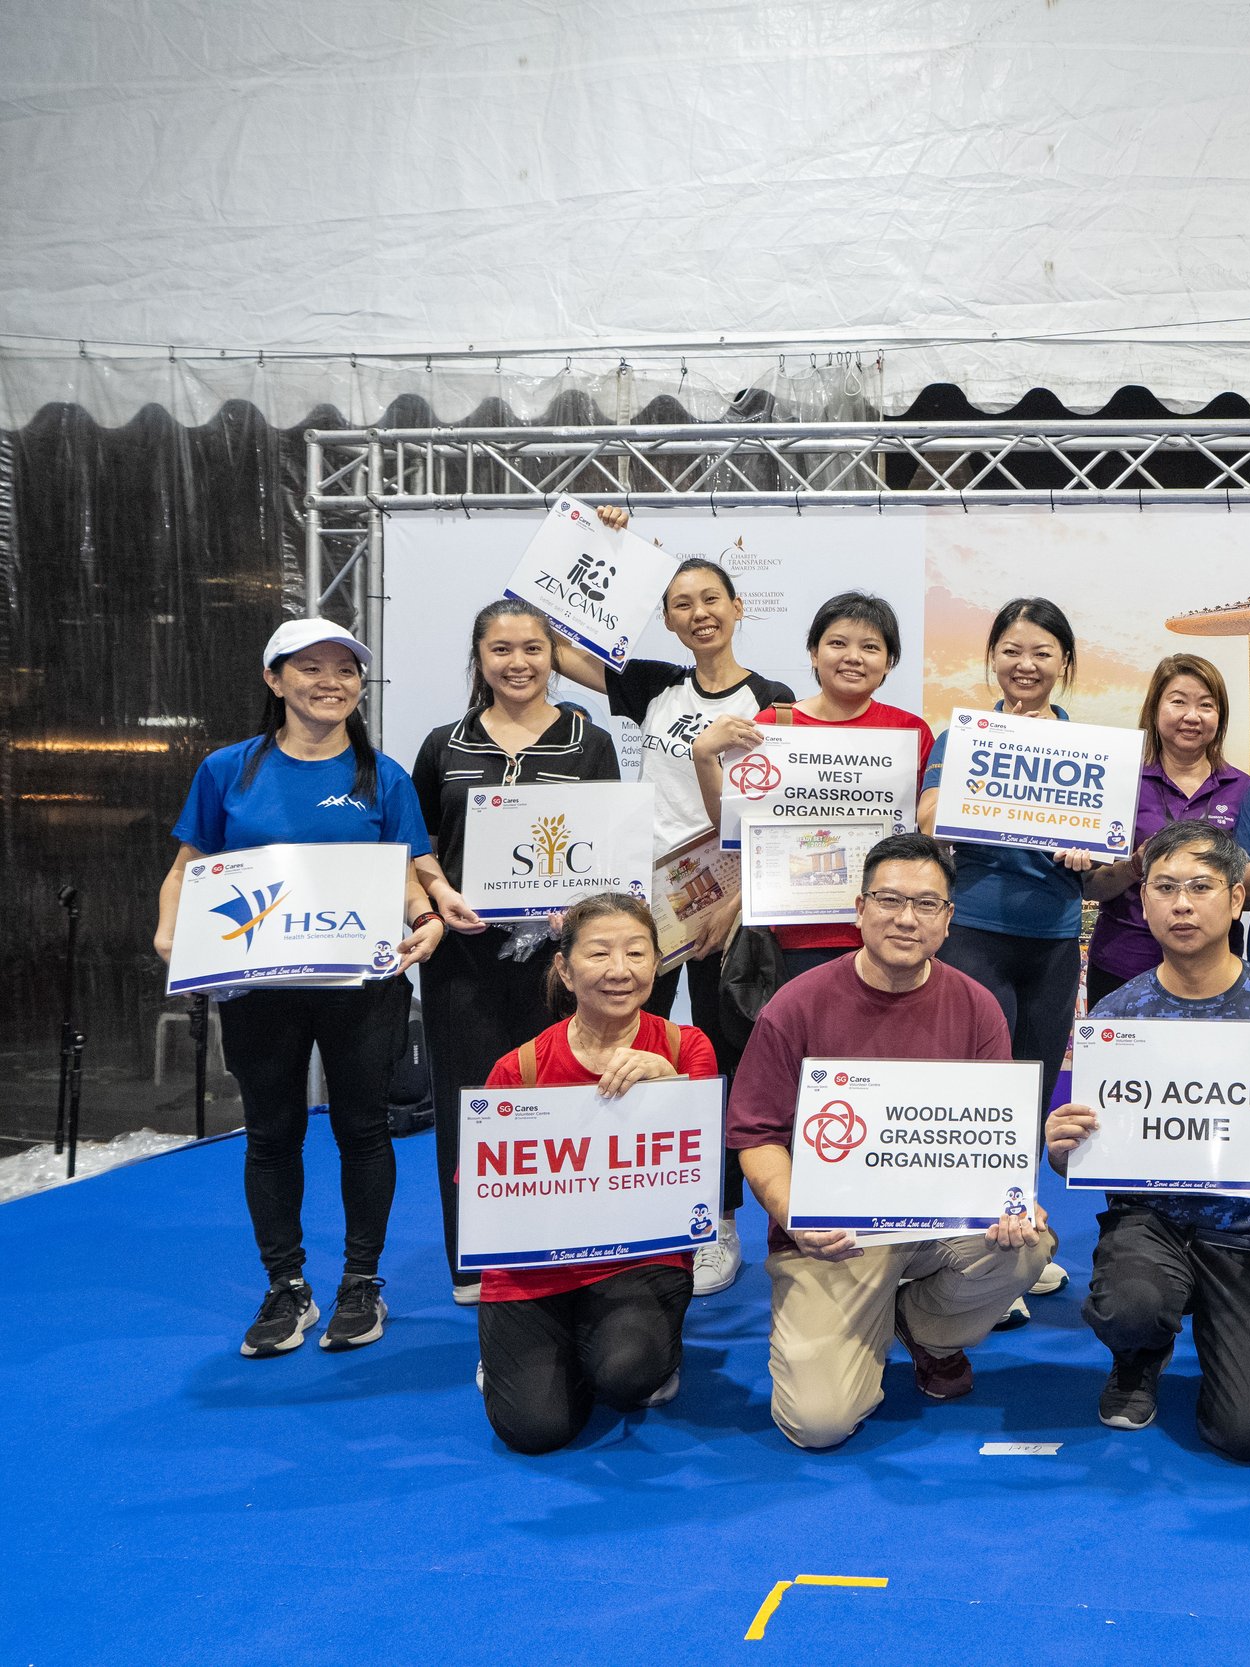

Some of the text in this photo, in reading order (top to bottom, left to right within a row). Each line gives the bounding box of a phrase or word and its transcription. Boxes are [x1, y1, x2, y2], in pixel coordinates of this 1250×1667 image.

[534, 570, 569, 600] ZEN
[569, 592, 618, 630] CANVAS
[642, 734, 670, 754] ZEN
[972, 740, 1110, 762] THE ORGANISATION OF
[788, 753, 892, 767] SEMBAWANG
[818, 770, 862, 784] WEST
[969, 750, 1105, 790] SENIOR
[784, 787, 894, 802] GRASSROOTS
[962, 804, 1101, 829] RSVP SINGAPORE
[484, 878, 620, 890] INSTITUTE OF LEARNING
[282, 910, 366, 933] HSA
[336, 932, 366, 940] Authority
[244, 970, 250, 978] To
[251, 969, 266, 978] Serve
[266, 968, 278, 976] with
[278, 967, 291, 975] Love
[301, 966, 314, 974] Care
[1099, 1080, 1152, 1108] (4S)
[886, 1106, 1013, 1122] WOODLANDS
[880, 1129, 1017, 1145] GRASSROOTS
[1143, 1117, 1230, 1141] HOME
[477, 1137, 591, 1176] NEW
[865, 1152, 1029, 1168] ORGANISATIONS
[477, 1168, 701, 1198] COMMUNITY SERVICES
[1146, 1180, 1152, 1188] To
[1153, 1180, 1168, 1188] Serve
[1204, 1181, 1217, 1189] Care
[872, 1218, 945, 1228] To Serve with Love and Care
[550, 1245, 629, 1261] To Serve with Love and Care
